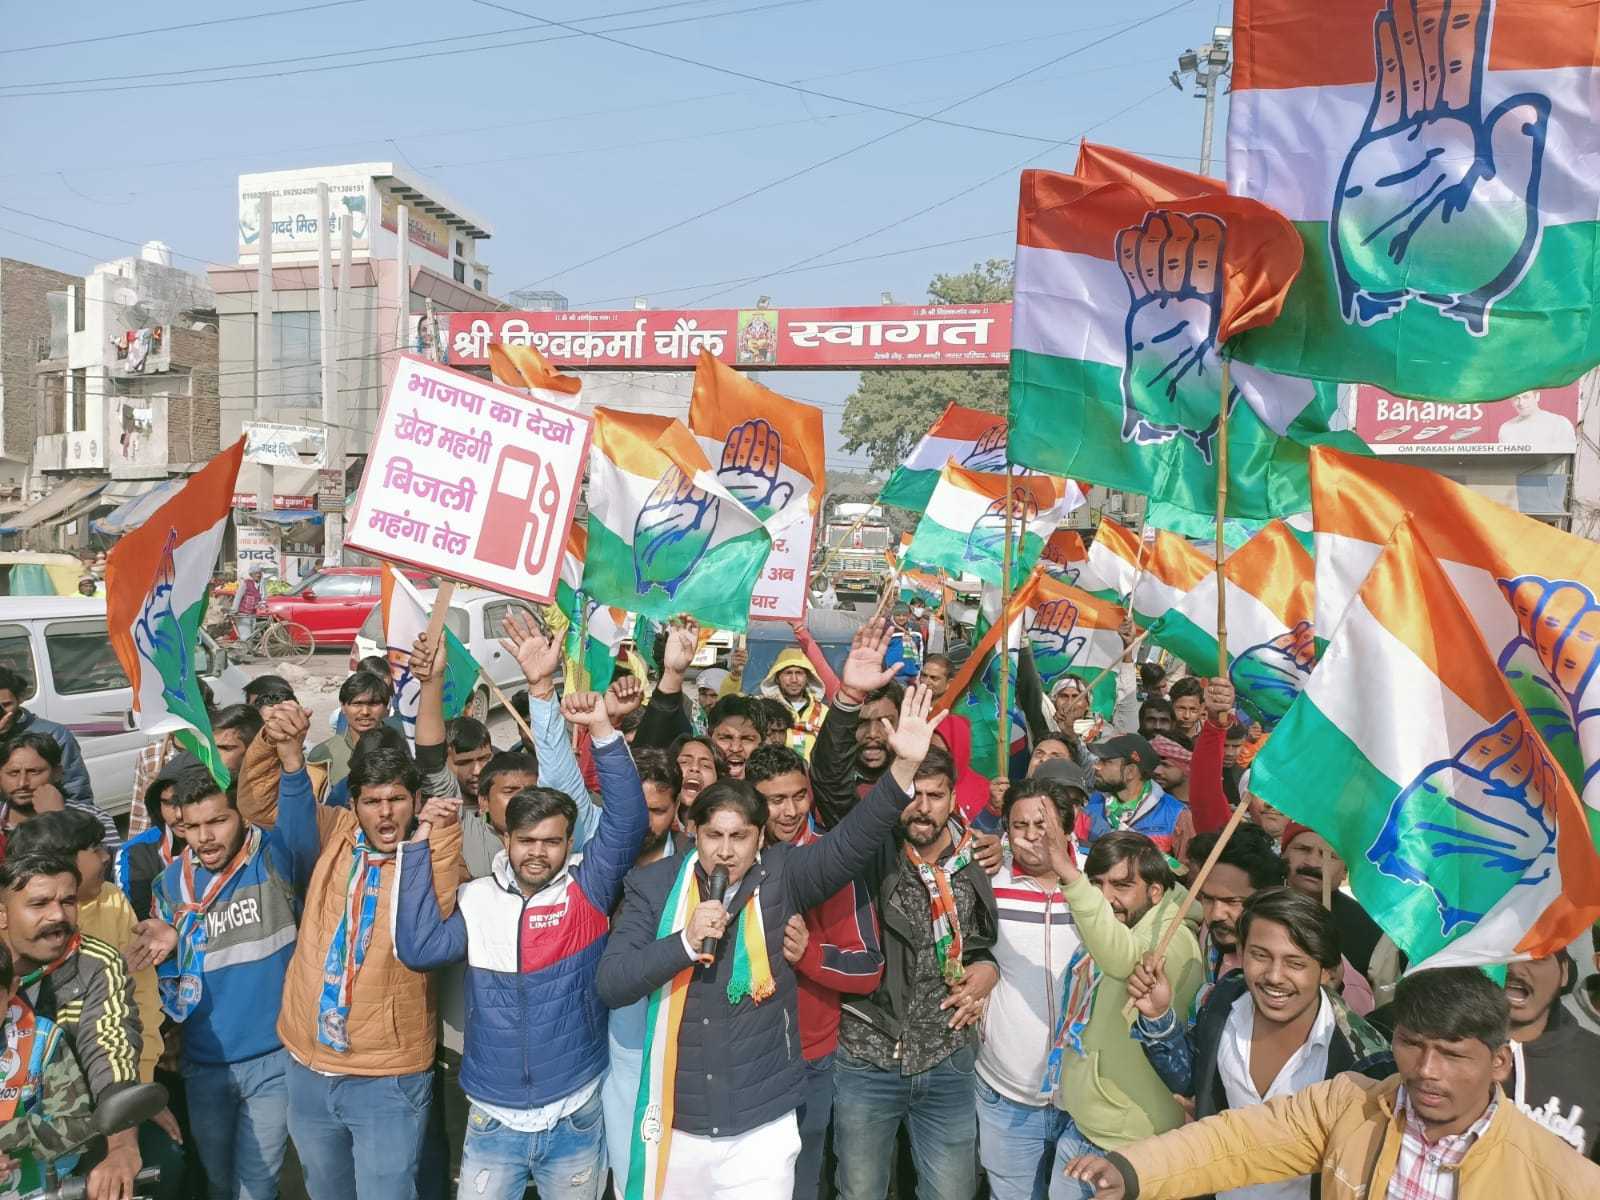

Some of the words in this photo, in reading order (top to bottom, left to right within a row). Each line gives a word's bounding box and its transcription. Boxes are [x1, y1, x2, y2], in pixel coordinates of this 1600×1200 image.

[453, 319, 494, 359] श्री
[787, 317, 996, 348] स्वागत
[407, 373, 487, 415] भाजपा
[489, 399, 523, 428] का
[526, 408, 576, 446] देखो
[1376, 398, 1485, 423] Bahamas
[394, 408, 438, 447] खेल
[437, 427, 493, 464] महंगी
[1398, 444, 1414, 453] OM
[1415, 444, 1455, 453] PRAKASH
[1456, 444, 1496, 453] MUKESH
[1496, 444, 1533, 453] CHAND
[382, 455, 479, 513] बिजली
[368, 509, 430, 545] महंगा
[432, 520, 471, 556] तेल
[768, 567, 796, 582] अब
